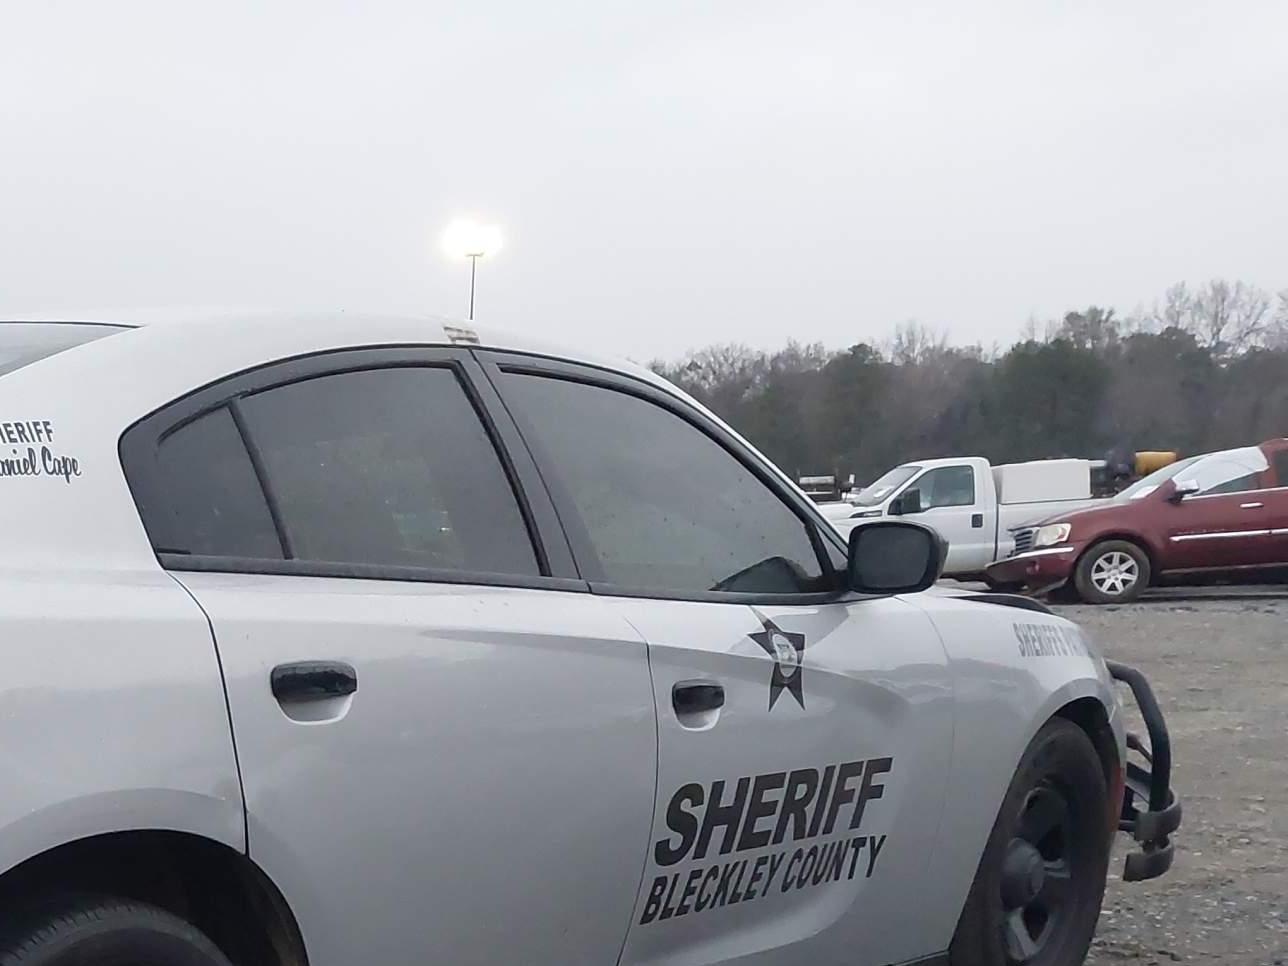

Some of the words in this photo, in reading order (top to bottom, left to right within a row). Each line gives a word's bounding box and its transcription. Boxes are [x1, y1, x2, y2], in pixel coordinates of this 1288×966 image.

[654, 757, 894, 867] SHERIFF
[639, 852, 786, 926] BLECKLEY
[781, 834, 888, 893] COUNTY
